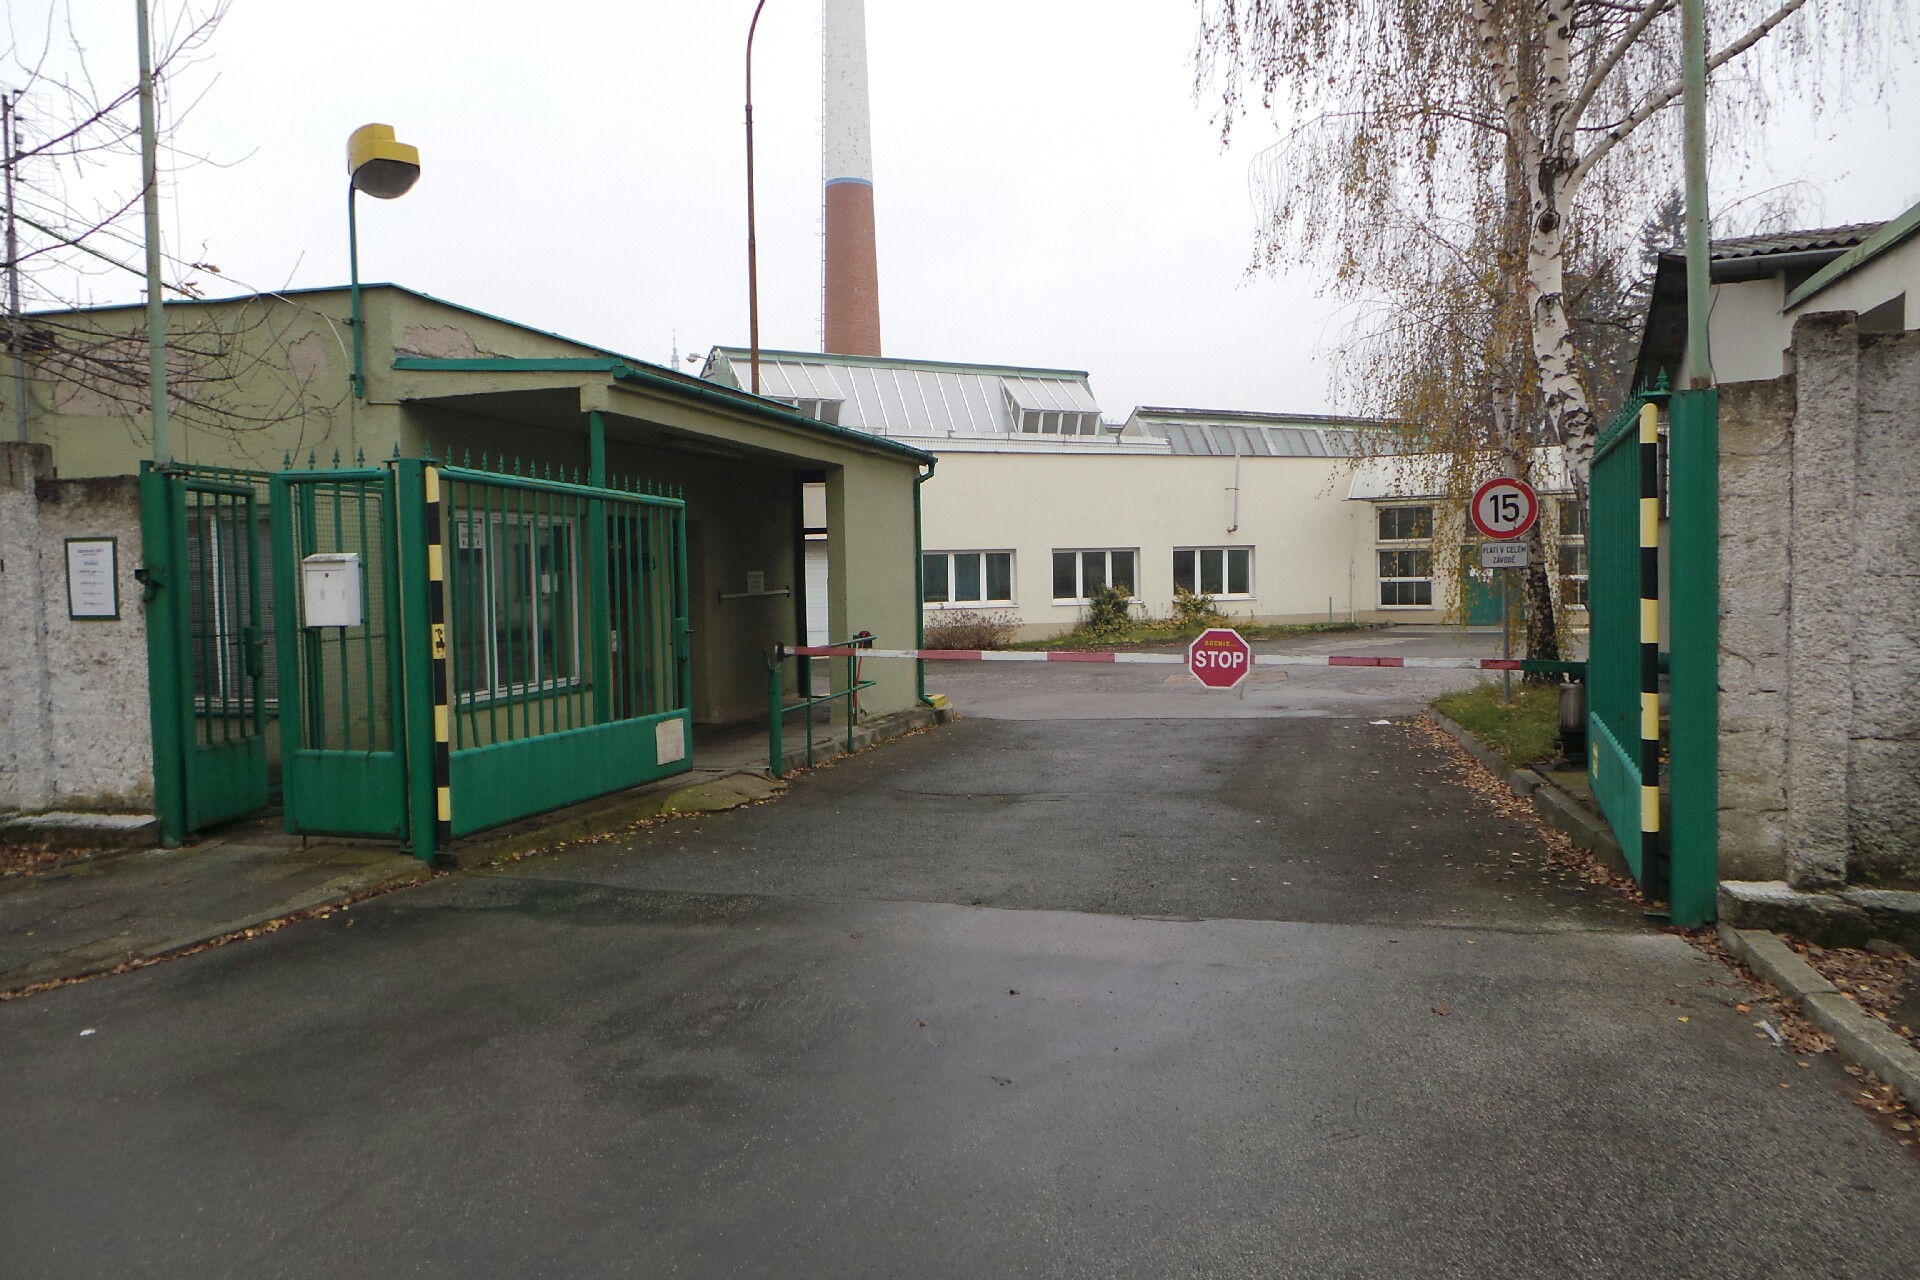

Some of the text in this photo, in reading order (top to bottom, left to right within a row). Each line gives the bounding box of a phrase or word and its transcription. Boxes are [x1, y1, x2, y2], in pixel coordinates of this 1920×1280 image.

[1490, 494, 1519, 523] 15
[1507, 545, 1526, 554] CELÉM
[1195, 650, 1244, 668] STOP
